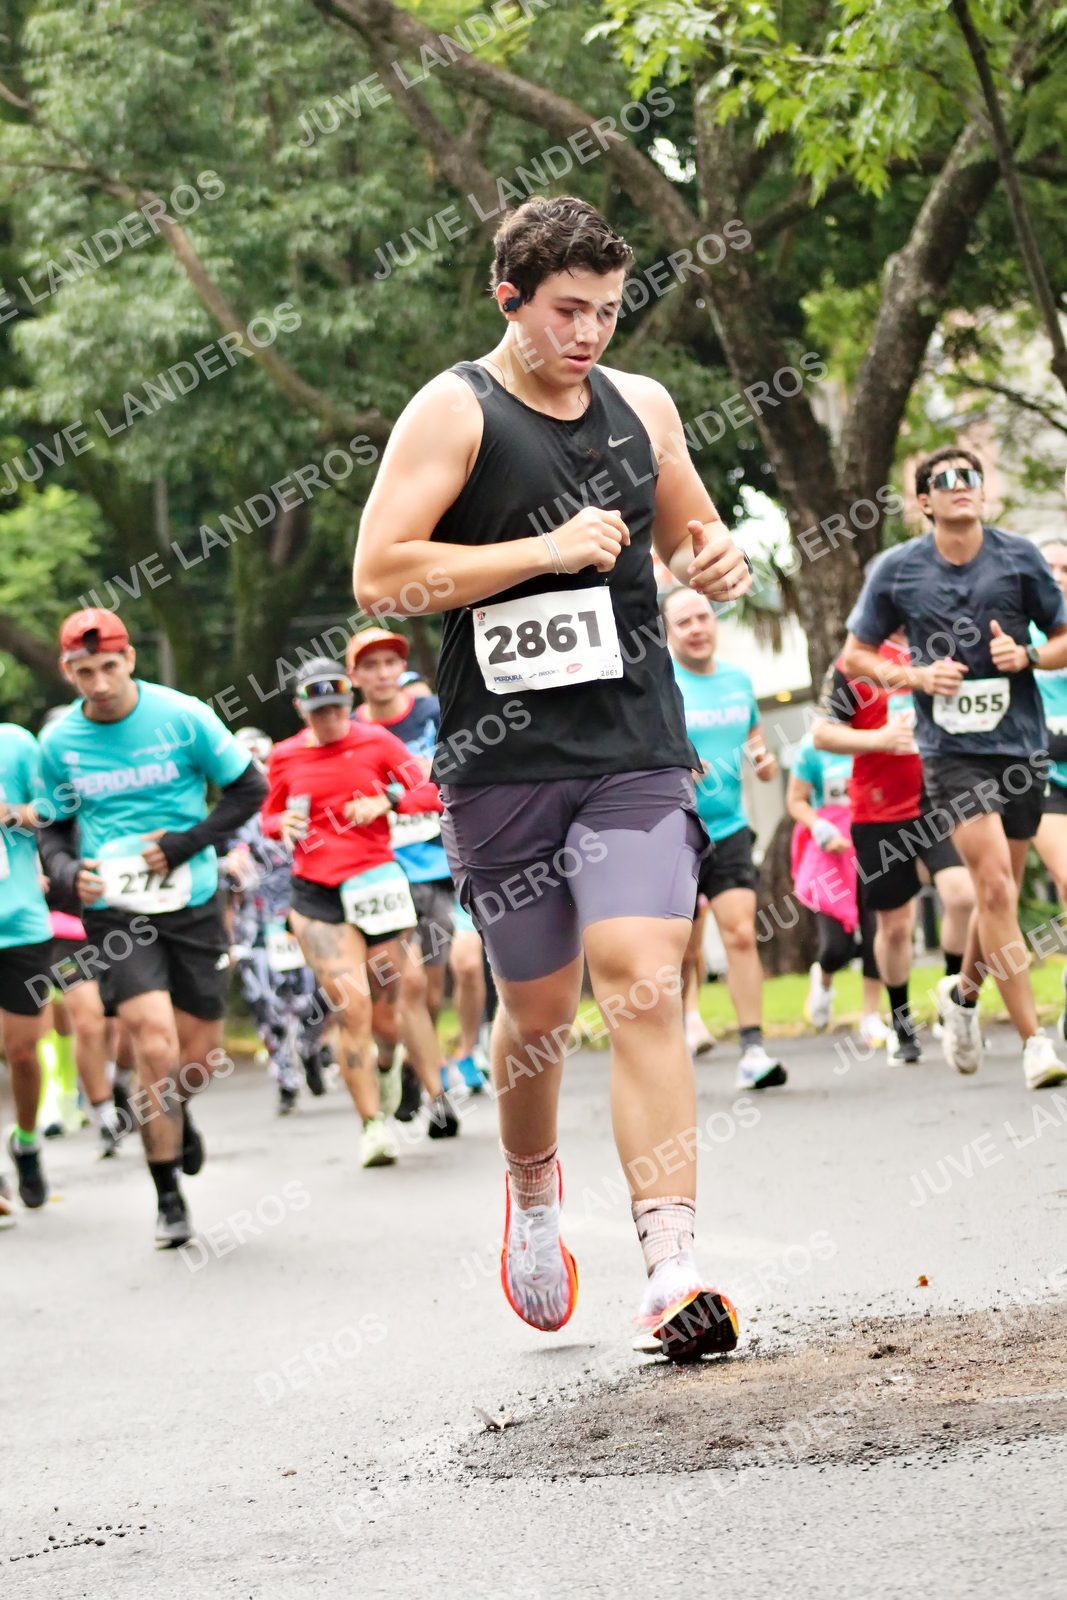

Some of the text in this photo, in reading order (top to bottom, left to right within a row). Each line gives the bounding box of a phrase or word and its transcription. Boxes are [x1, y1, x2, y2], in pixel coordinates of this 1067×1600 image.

[483, 610, 602, 666] 2861
[494, 674, 523, 684] PERDURA
[600, 669, 618, 677] 2861
[71, 761, 180, 797] PERDURA
